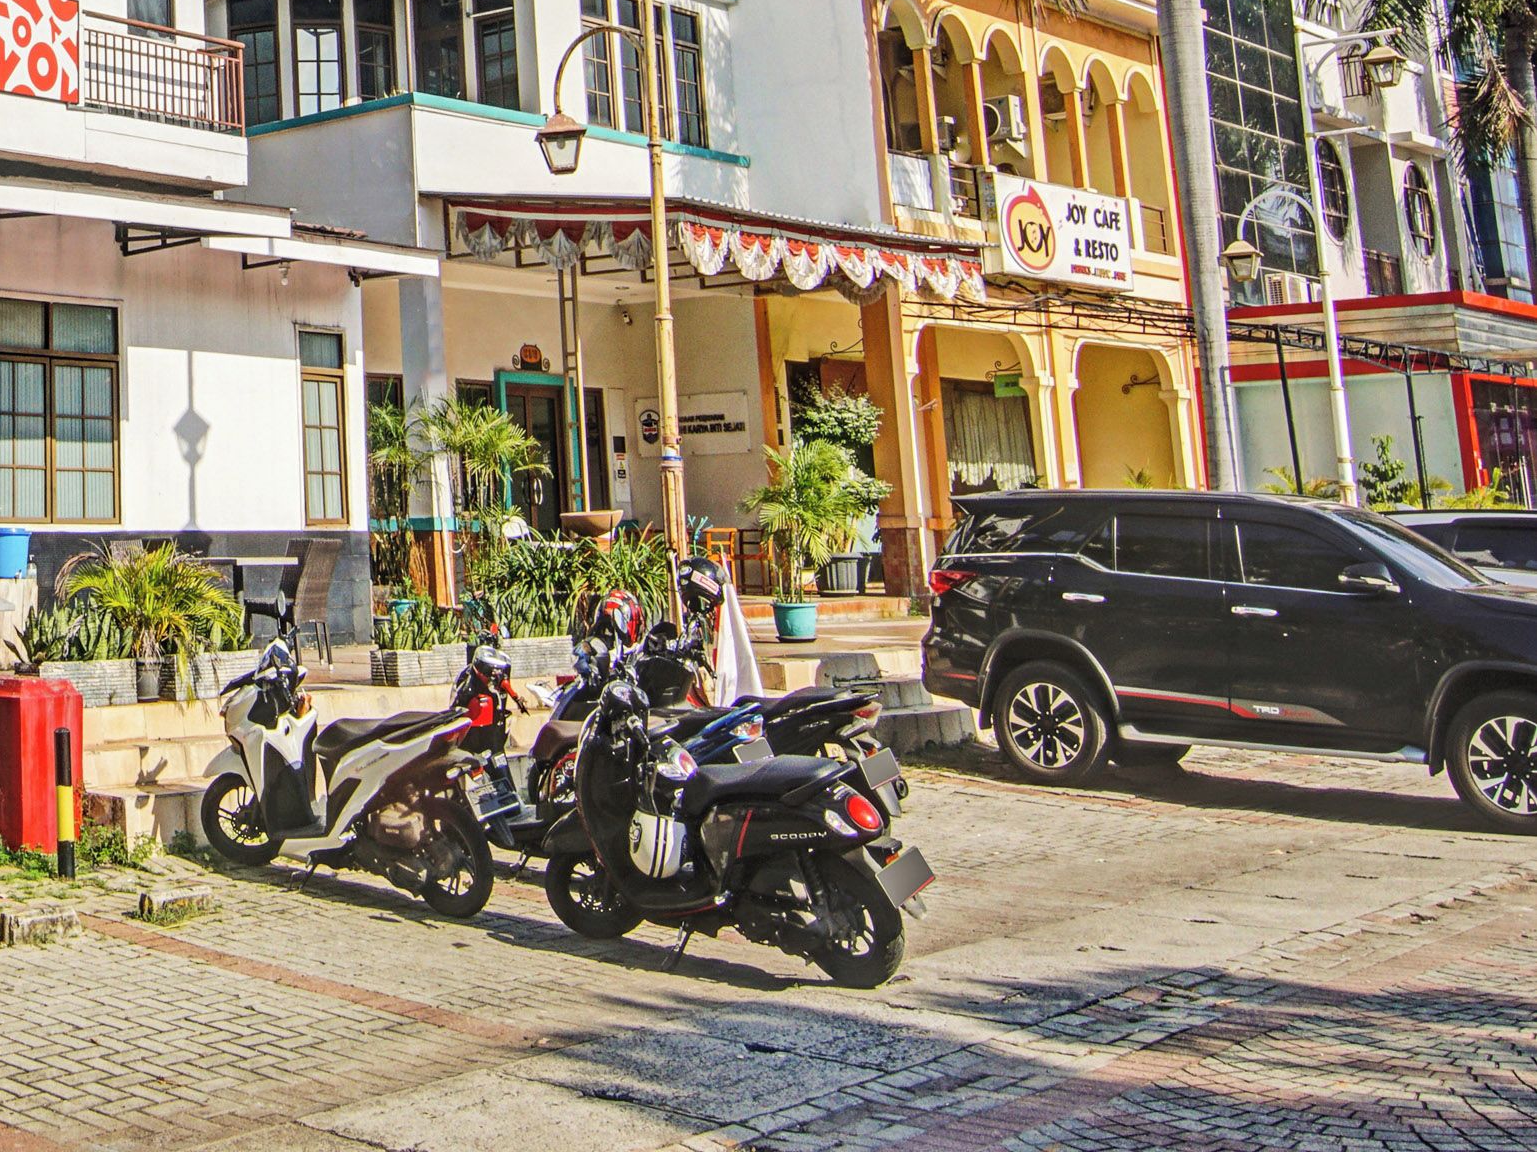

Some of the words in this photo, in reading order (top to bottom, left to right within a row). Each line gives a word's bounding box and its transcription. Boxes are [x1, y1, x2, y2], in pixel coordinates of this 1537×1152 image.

[1066, 202, 1087, 225] JOY
[1017, 219, 1051, 258] JOY
[1084, 239, 1119, 262] RESTO
[1252, 705, 1280, 714] TRD
